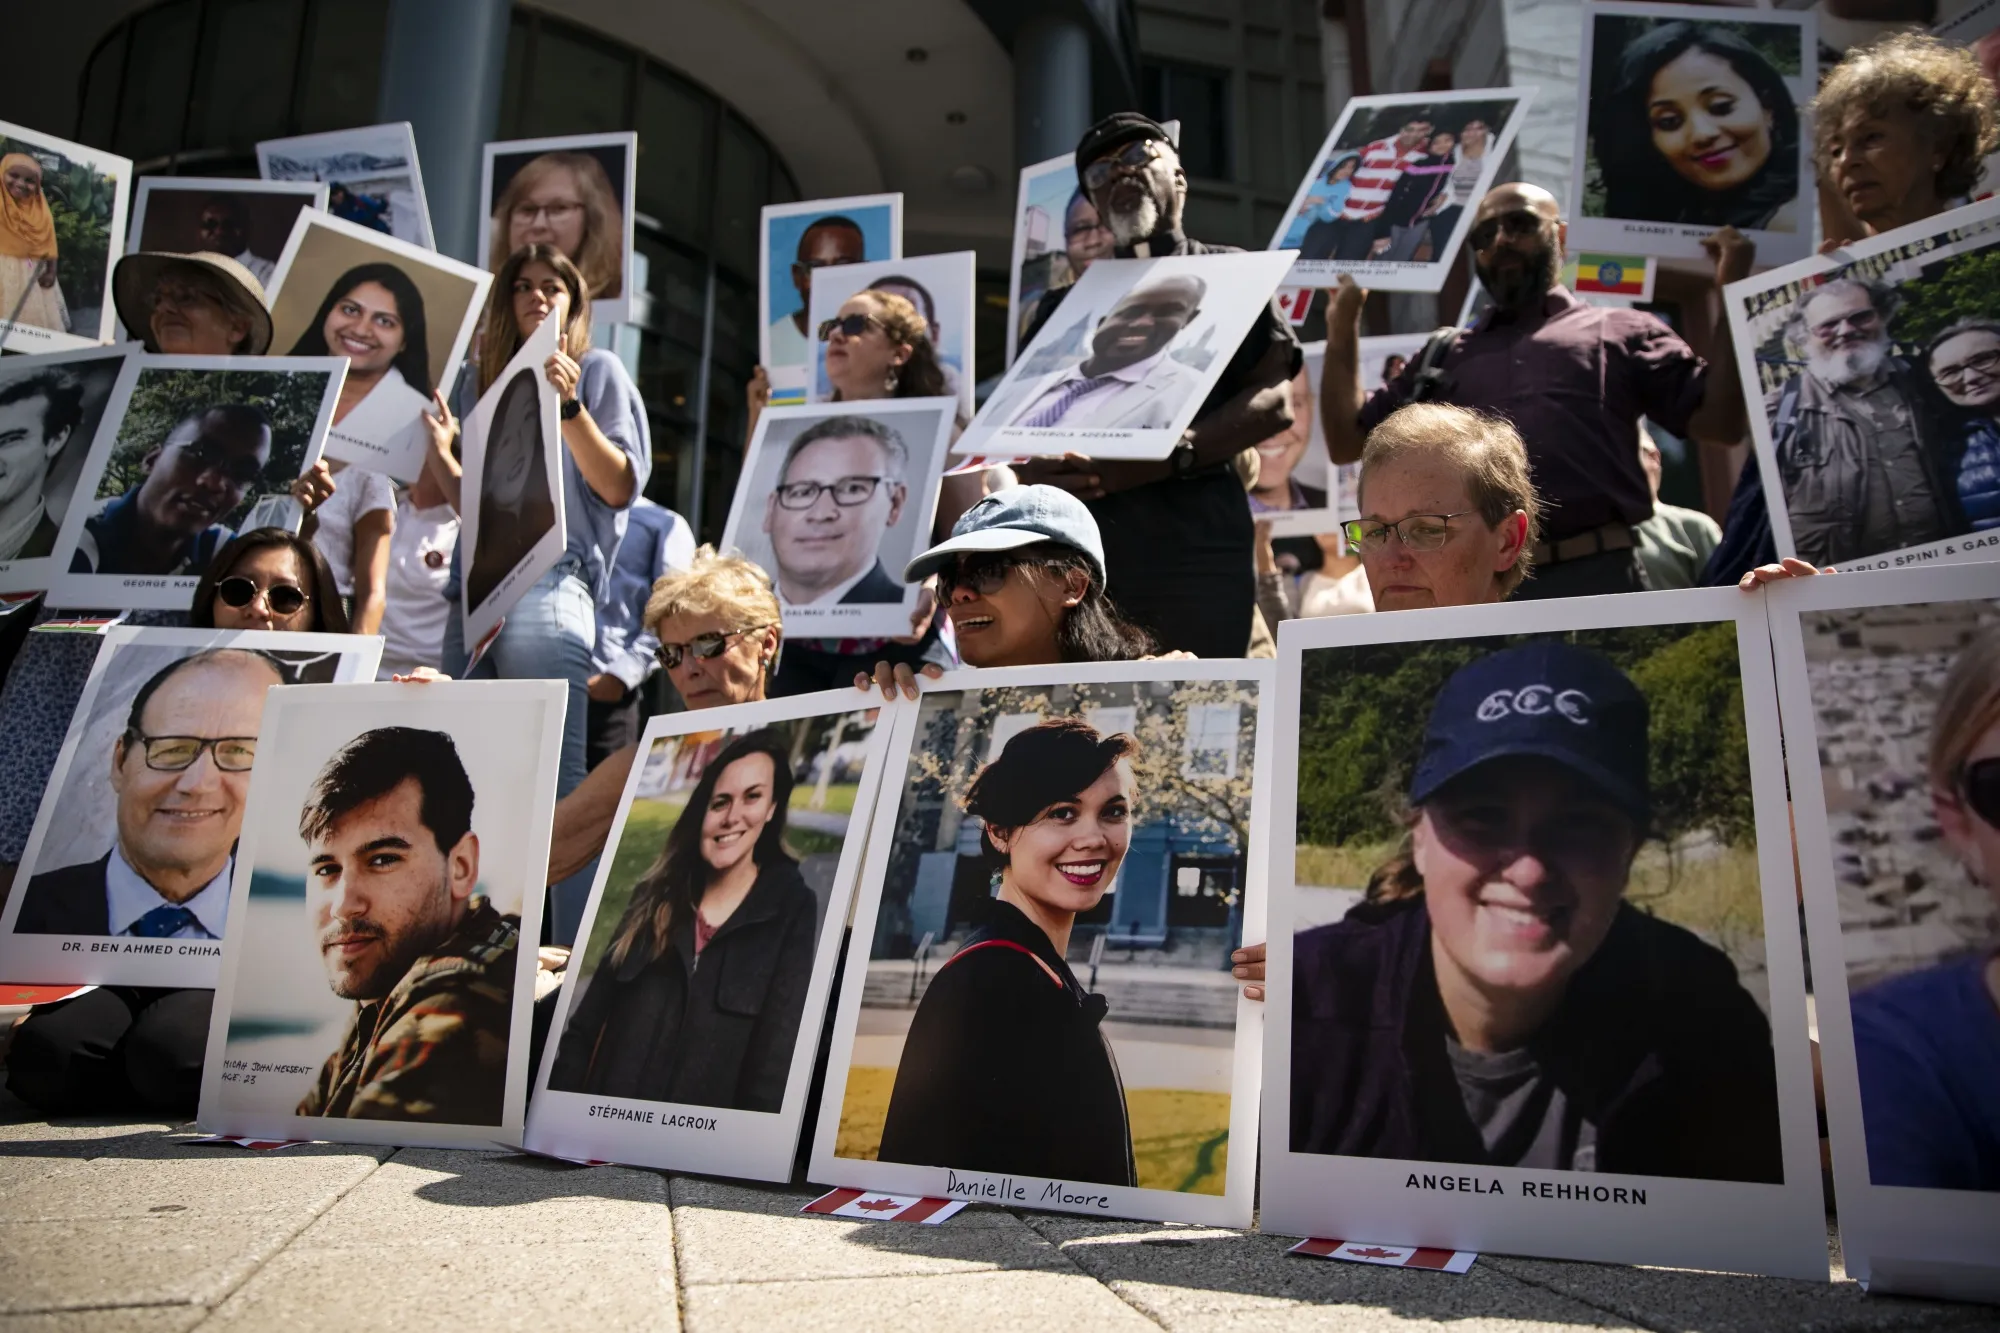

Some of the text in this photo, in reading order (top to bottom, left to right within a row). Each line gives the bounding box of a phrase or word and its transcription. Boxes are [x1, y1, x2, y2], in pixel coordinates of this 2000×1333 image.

[1895, 549, 1939, 566] SPINI
[1945, 544, 1956, 556] &
[1963, 535, 2000, 551] GAB
[123, 580, 198, 589] GEORGE KAB
[62, 942, 85, 952] DR.
[91, 943, 119, 953] BEN
[123, 944, 172, 955] AHMED
[223, 1060, 248, 1072] MICAH
[251, 1061, 274, 1073] JOHN
[221, 1072, 257, 1085] AGE: 23
[588, 1103, 718, 1131] STÉPHANIE LACROIX
[946, 1170, 1110, 1209] Danielle Moore
[1405, 1173, 1647, 1206] ANGELA REHHORN
